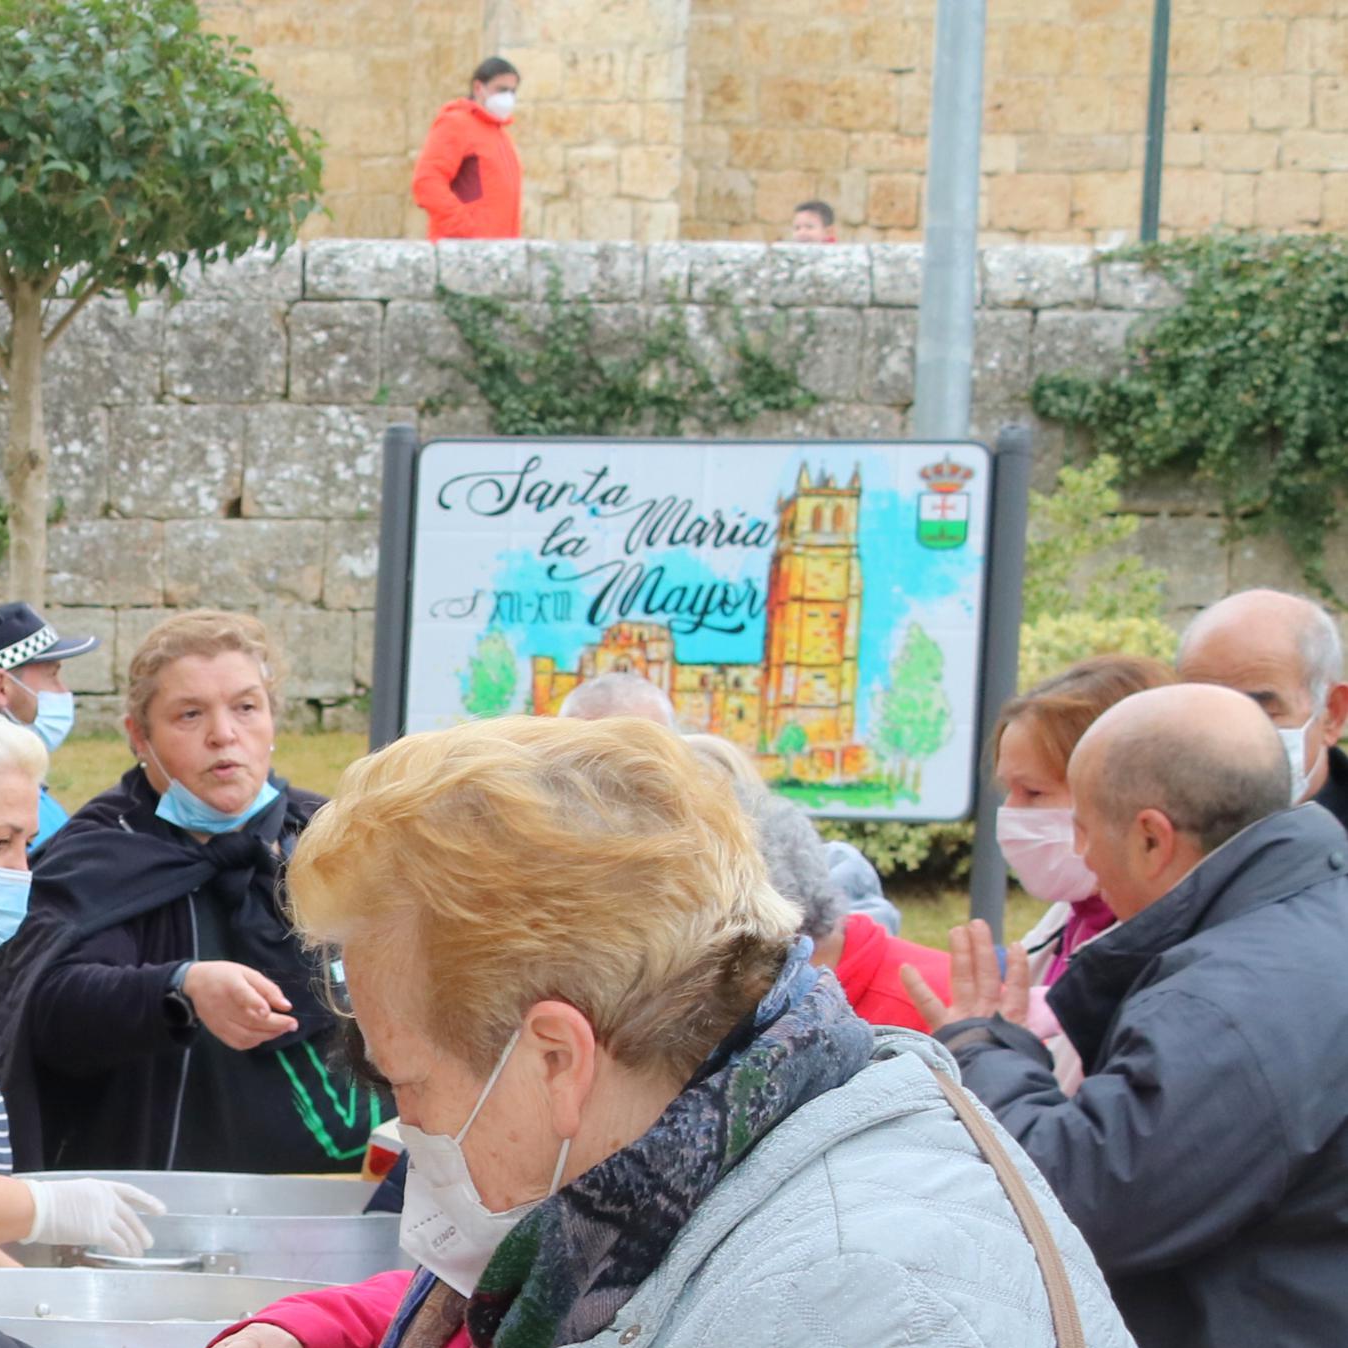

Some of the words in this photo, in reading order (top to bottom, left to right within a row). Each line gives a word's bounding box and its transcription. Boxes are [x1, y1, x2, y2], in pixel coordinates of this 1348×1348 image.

[437, 455, 631, 517] Santa
[592, 495, 776, 556] María
[539, 515, 592, 558] la
[547, 559, 766, 635] Mayor
